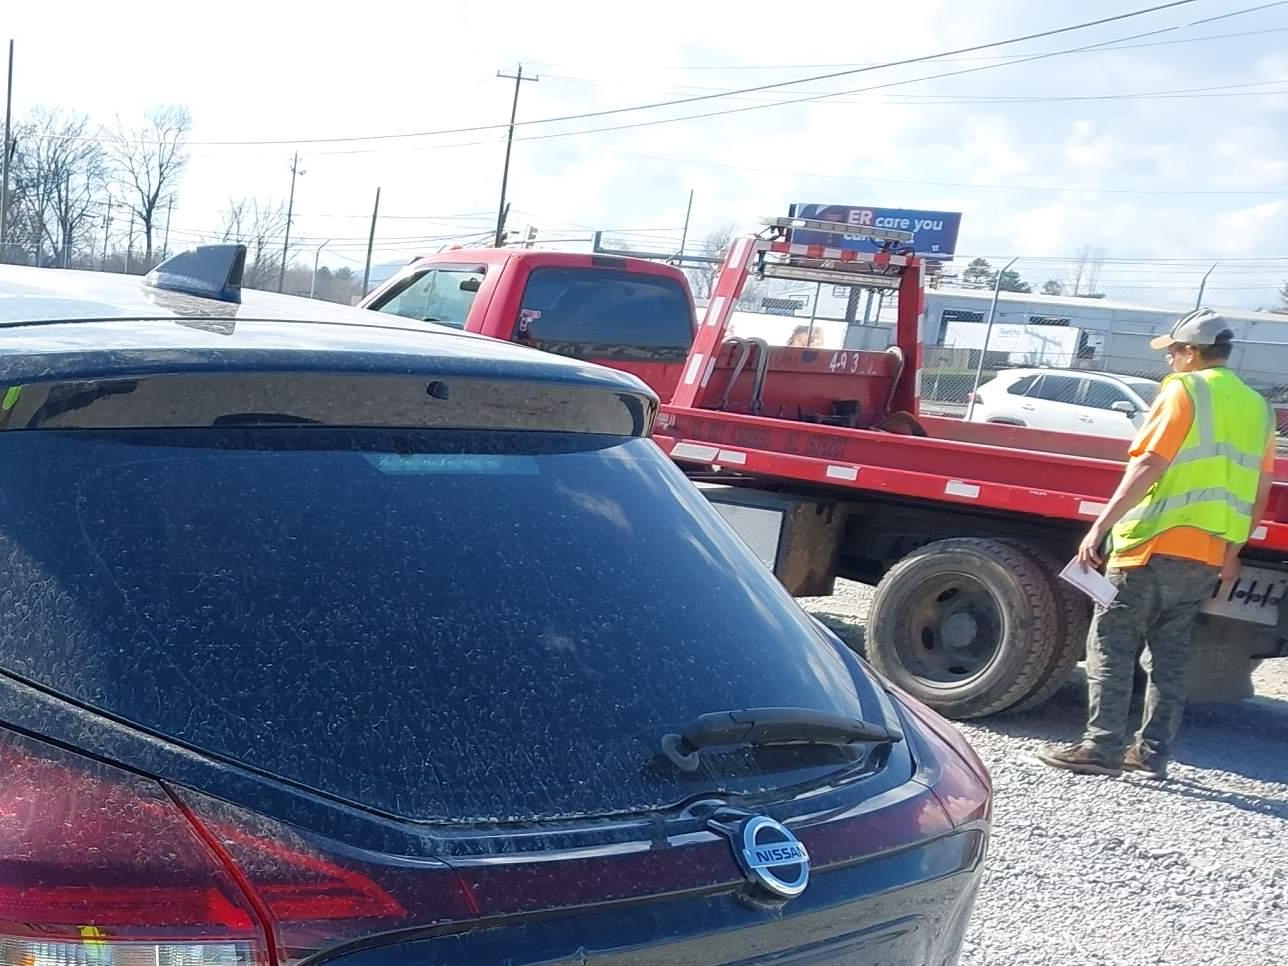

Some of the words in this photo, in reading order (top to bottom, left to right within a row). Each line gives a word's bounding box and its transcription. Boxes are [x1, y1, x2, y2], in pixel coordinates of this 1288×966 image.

[847, 209, 873, 225] ER
[875, 217, 910, 229] care
[912, 219, 943, 232] you
[755, 846, 806, 863] NISSAN
